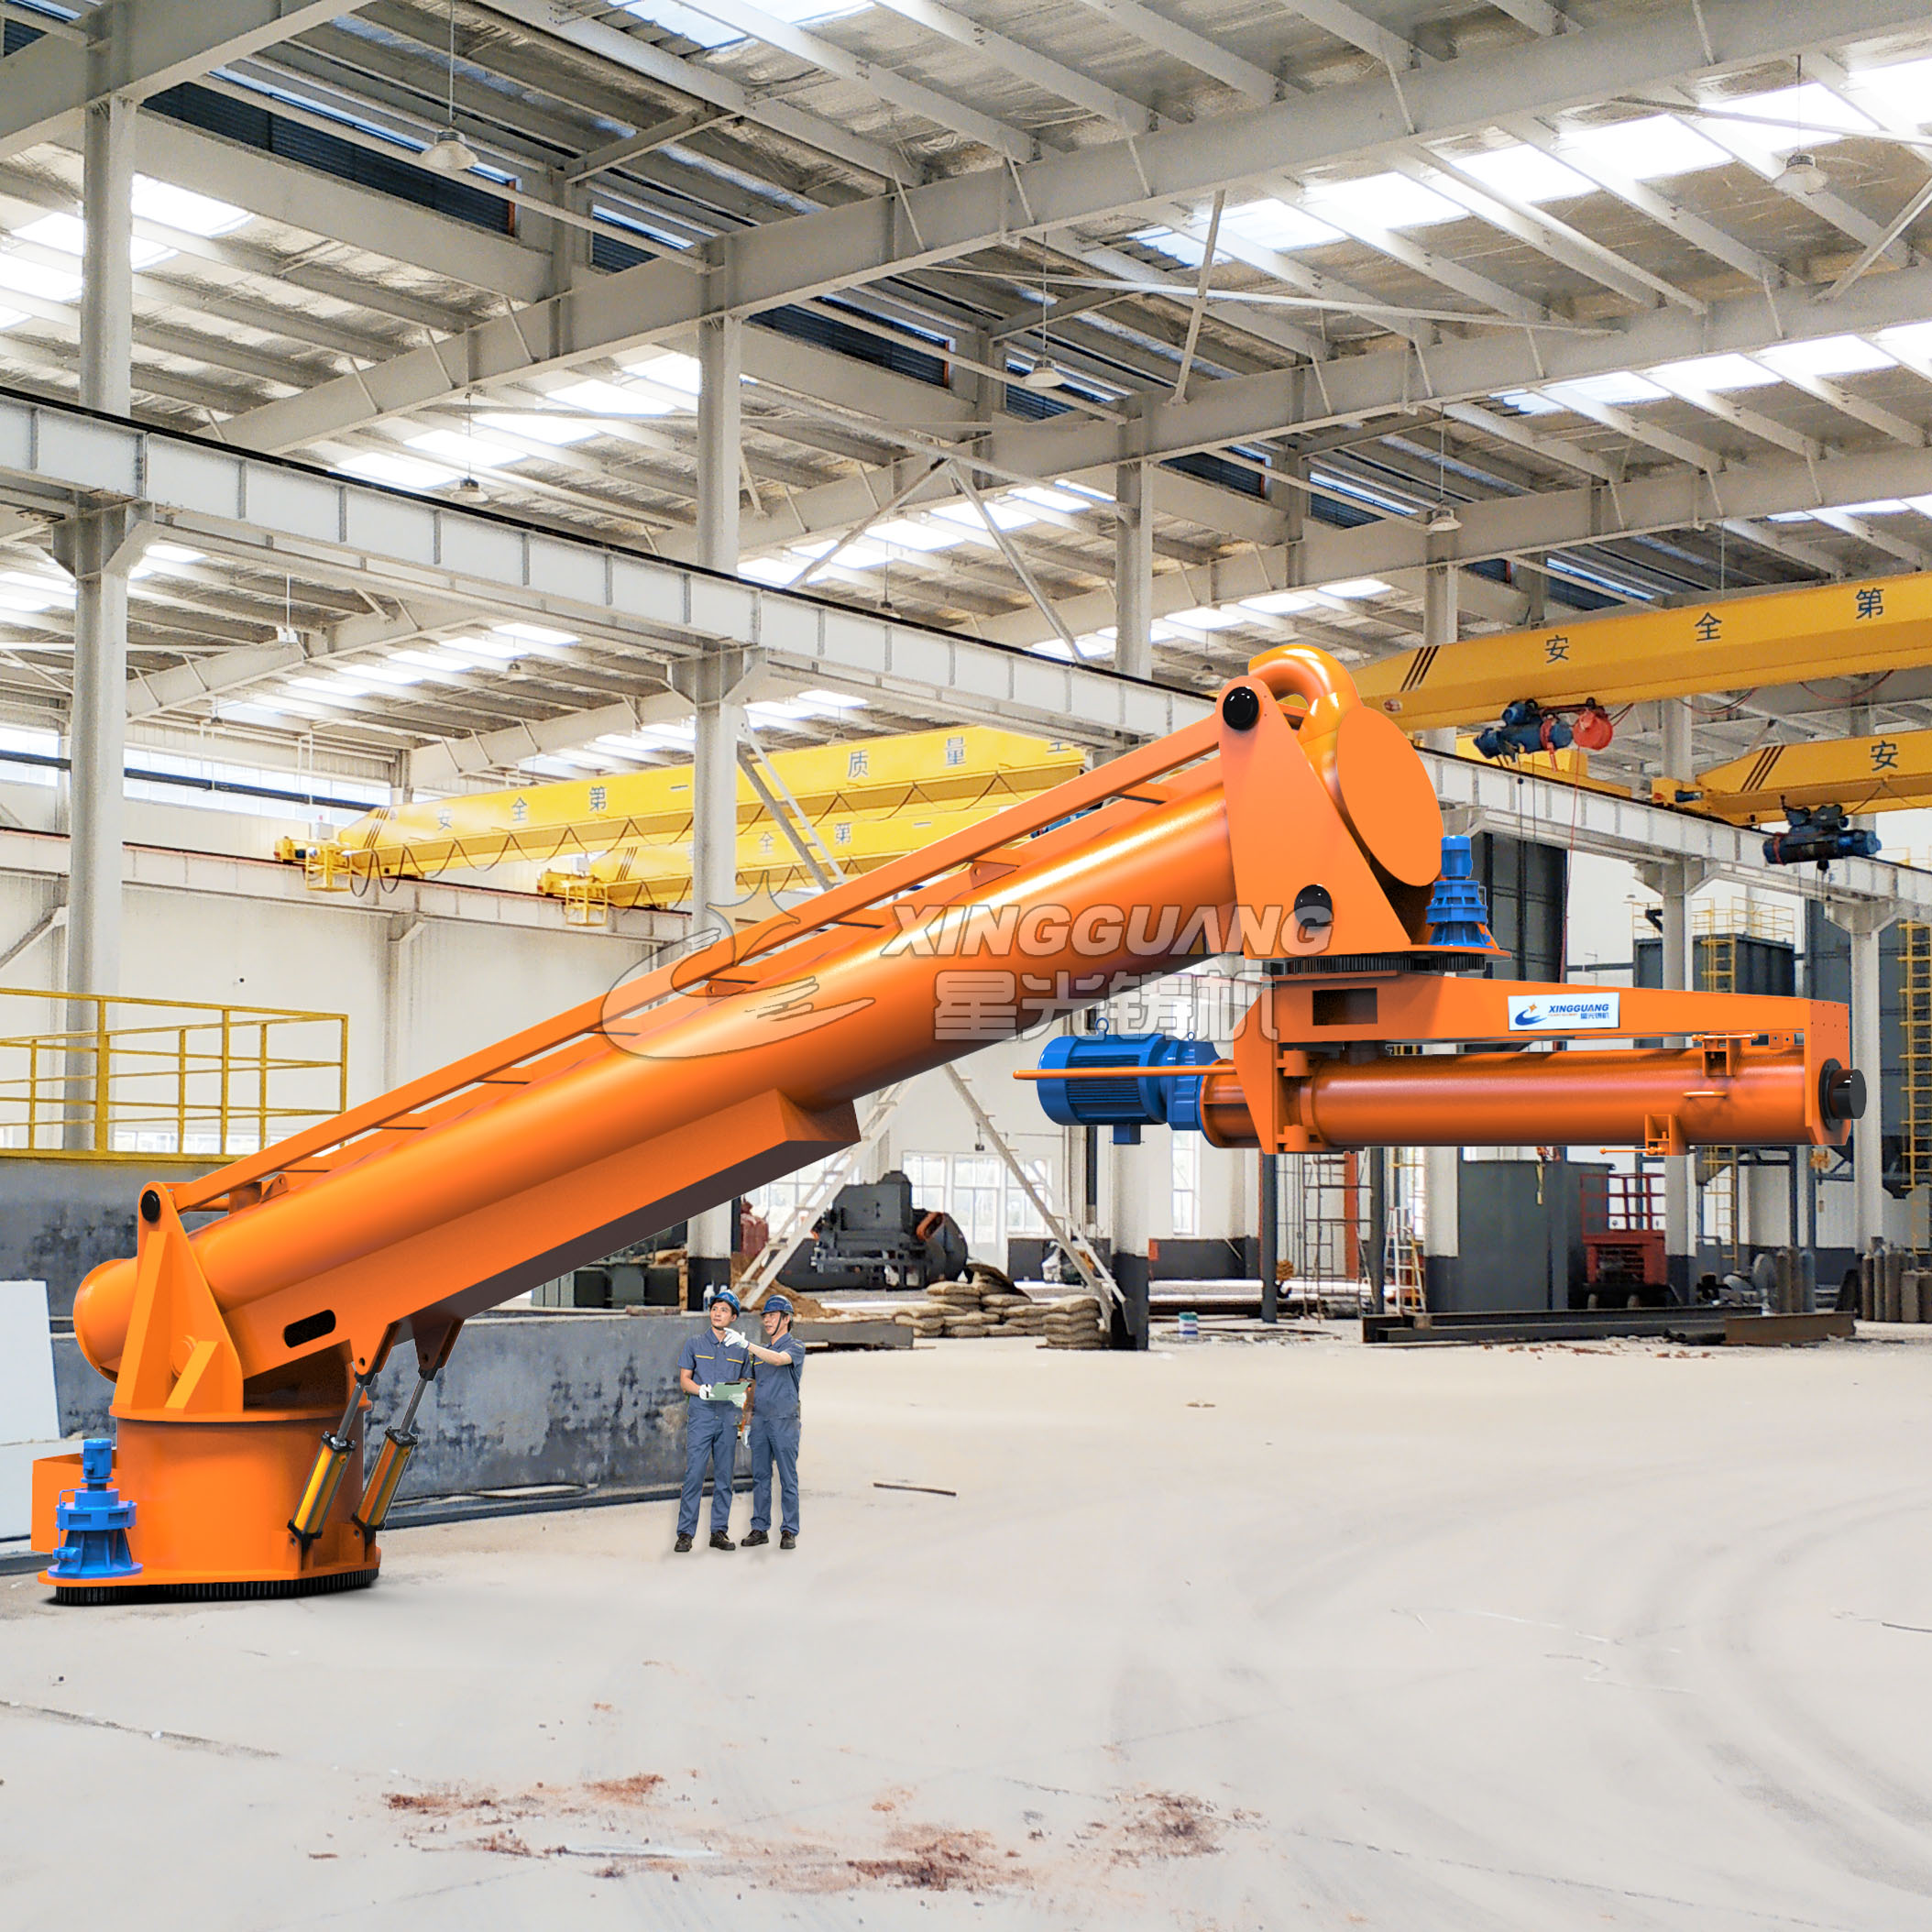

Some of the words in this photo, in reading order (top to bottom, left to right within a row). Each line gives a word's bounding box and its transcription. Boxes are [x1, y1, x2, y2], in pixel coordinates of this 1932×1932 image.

[1545, 587, 1885, 664] 安全第
[1870, 740, 1899, 772] 安
[437, 785, 689, 831] 安全第一
[1548, 1004, 1609, 1013] XINGGUANG
